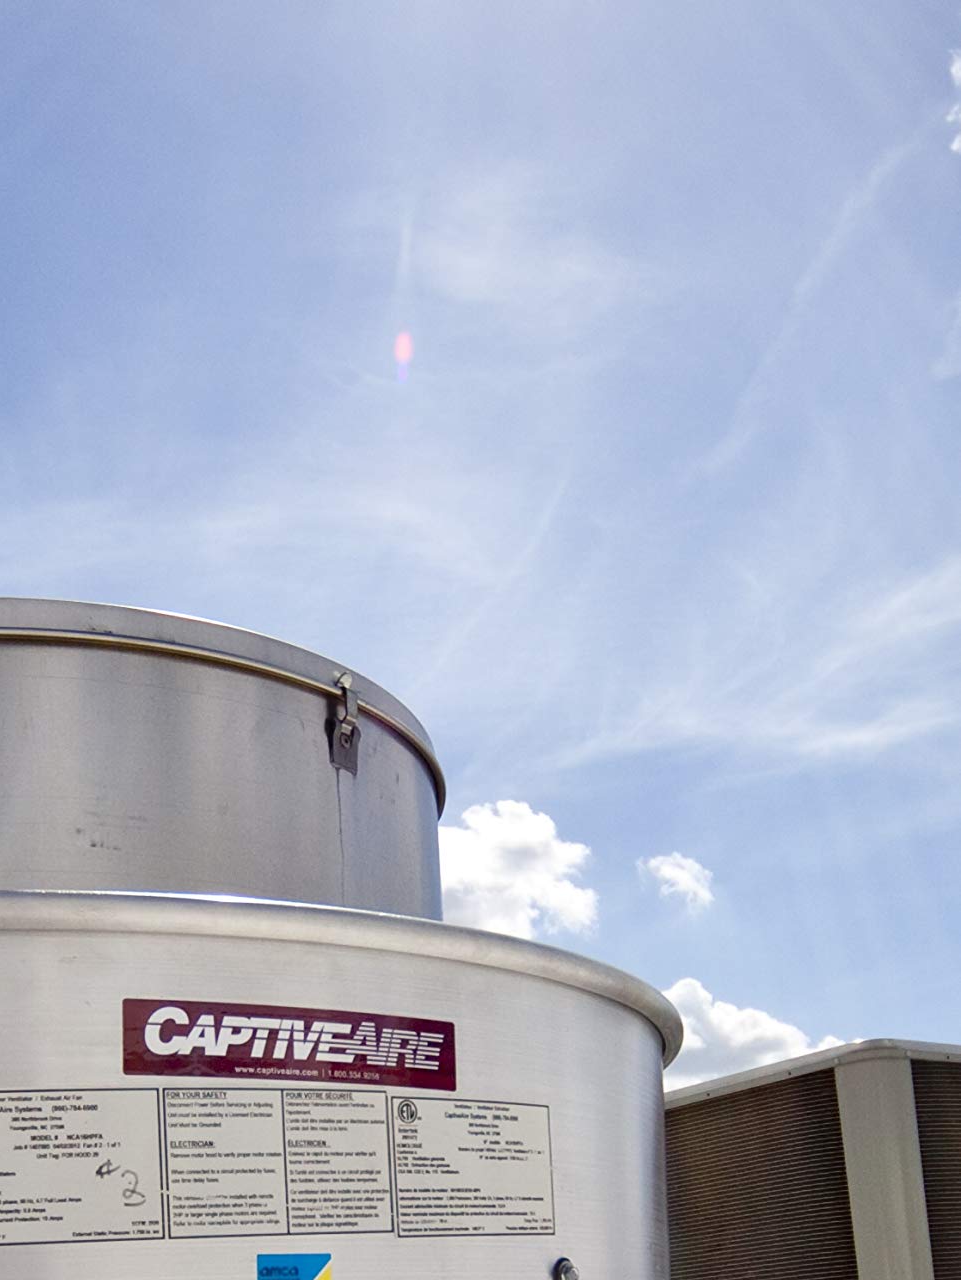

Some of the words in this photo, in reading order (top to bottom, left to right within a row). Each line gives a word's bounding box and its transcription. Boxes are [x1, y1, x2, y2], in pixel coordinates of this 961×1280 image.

[144, 1006, 444, 1070] CAPTIVEAIRE
[235, 1066, 318, 1077] www.captiveaire.com
[14, 1106, 42, 1114] Systems
[260, 1266, 299, 1277] amca
